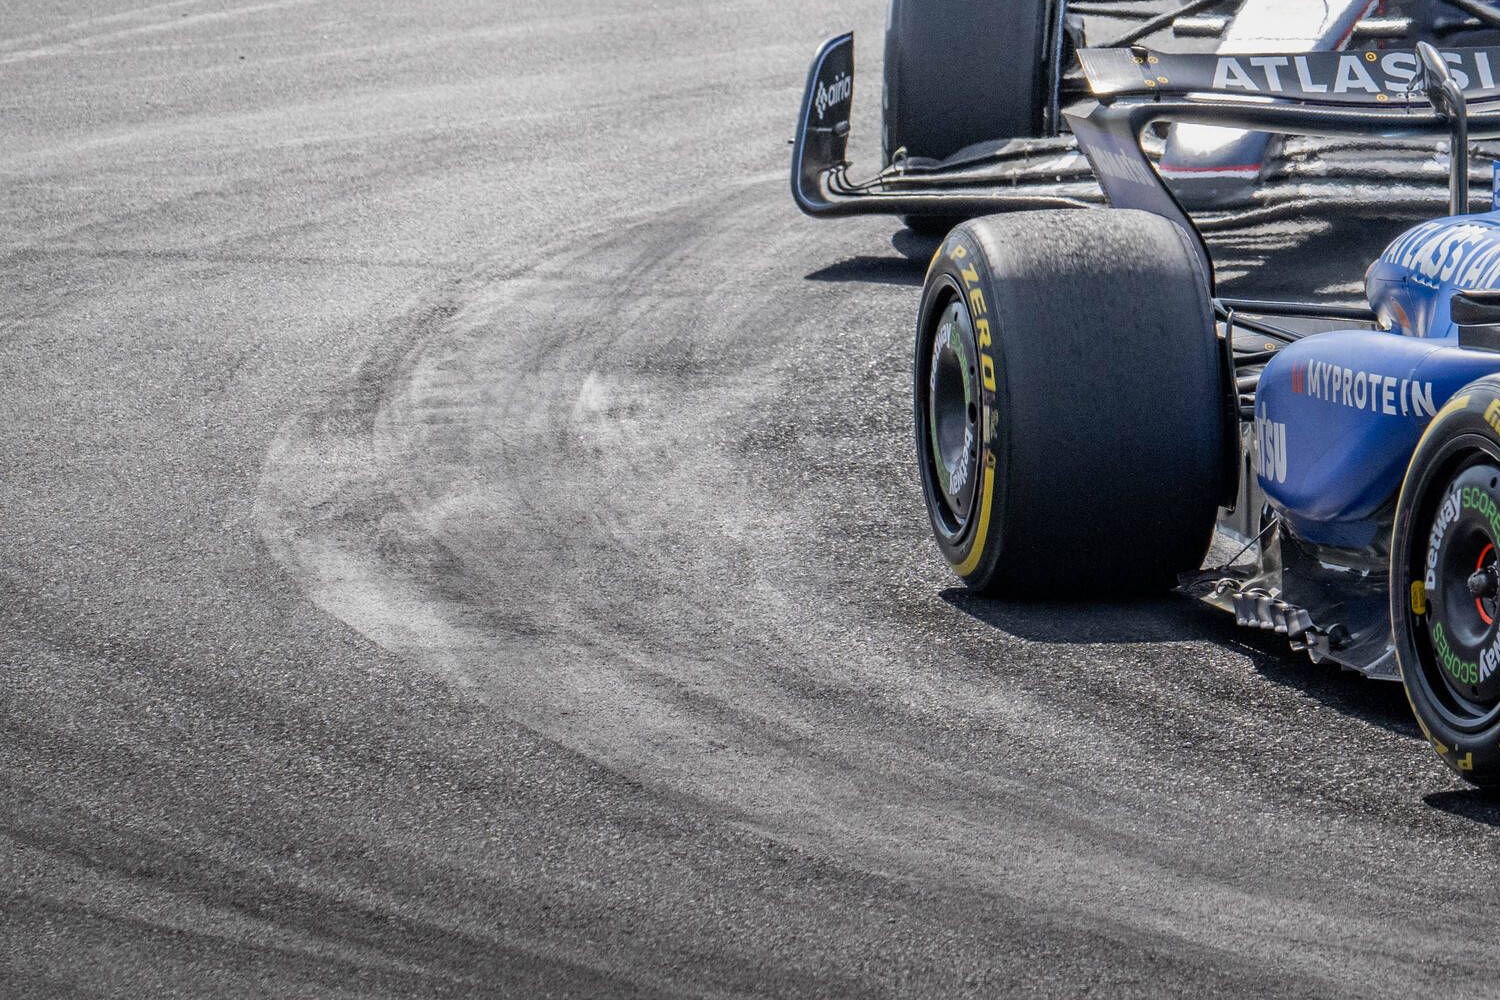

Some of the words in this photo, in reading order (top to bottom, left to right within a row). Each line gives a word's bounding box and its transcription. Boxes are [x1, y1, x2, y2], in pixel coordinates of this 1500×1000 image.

[829, 71, 852, 105] airia
[950, 244, 967, 260] P
[961, 262, 997, 393] ZERO
[1307, 358, 1438, 417] MYPROTEIN
[1424, 488, 1462, 590] betway
[1432, 621, 1478, 684] SCORES
